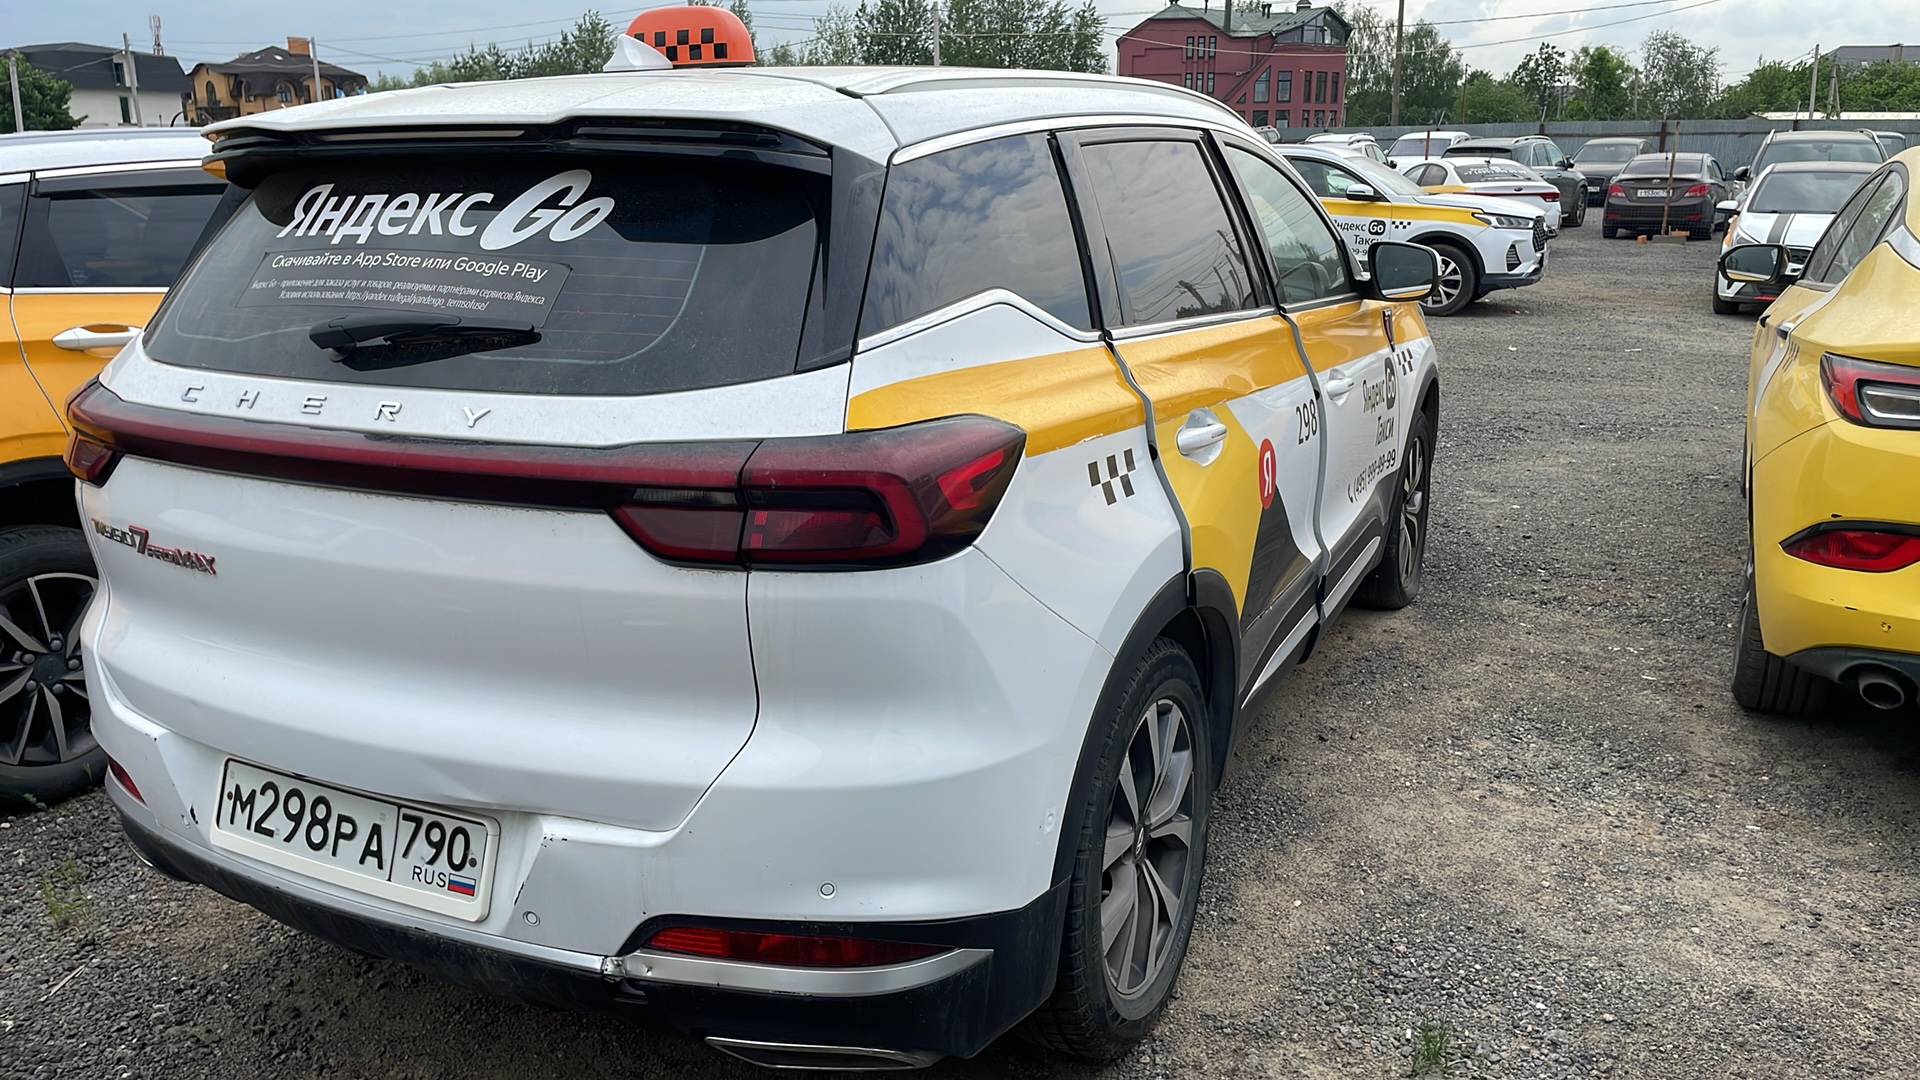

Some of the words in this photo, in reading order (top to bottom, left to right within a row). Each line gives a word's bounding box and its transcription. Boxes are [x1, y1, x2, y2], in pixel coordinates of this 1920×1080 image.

[276, 183, 495, 245] Яндекс
[479, 169, 615, 250] Go
[1333, 219, 1367, 232] ндекс
[1369, 221, 1385, 234] Go
[272, 252, 342, 269] Скачивайте
[342, 254, 352, 265] в
[352, 252, 382, 268] App
[382, 252, 421, 268] Store
[422, 257, 452, 270] или
[454, 256, 510, 277] Google
[511, 262, 548, 283] Play
[180, 384, 491, 428] CHERY
[1295, 398, 1318, 445] 298
[1263, 450, 1273, 497] Я
[402, 813, 472, 872] 790
[412, 864, 447, 888] RUS
